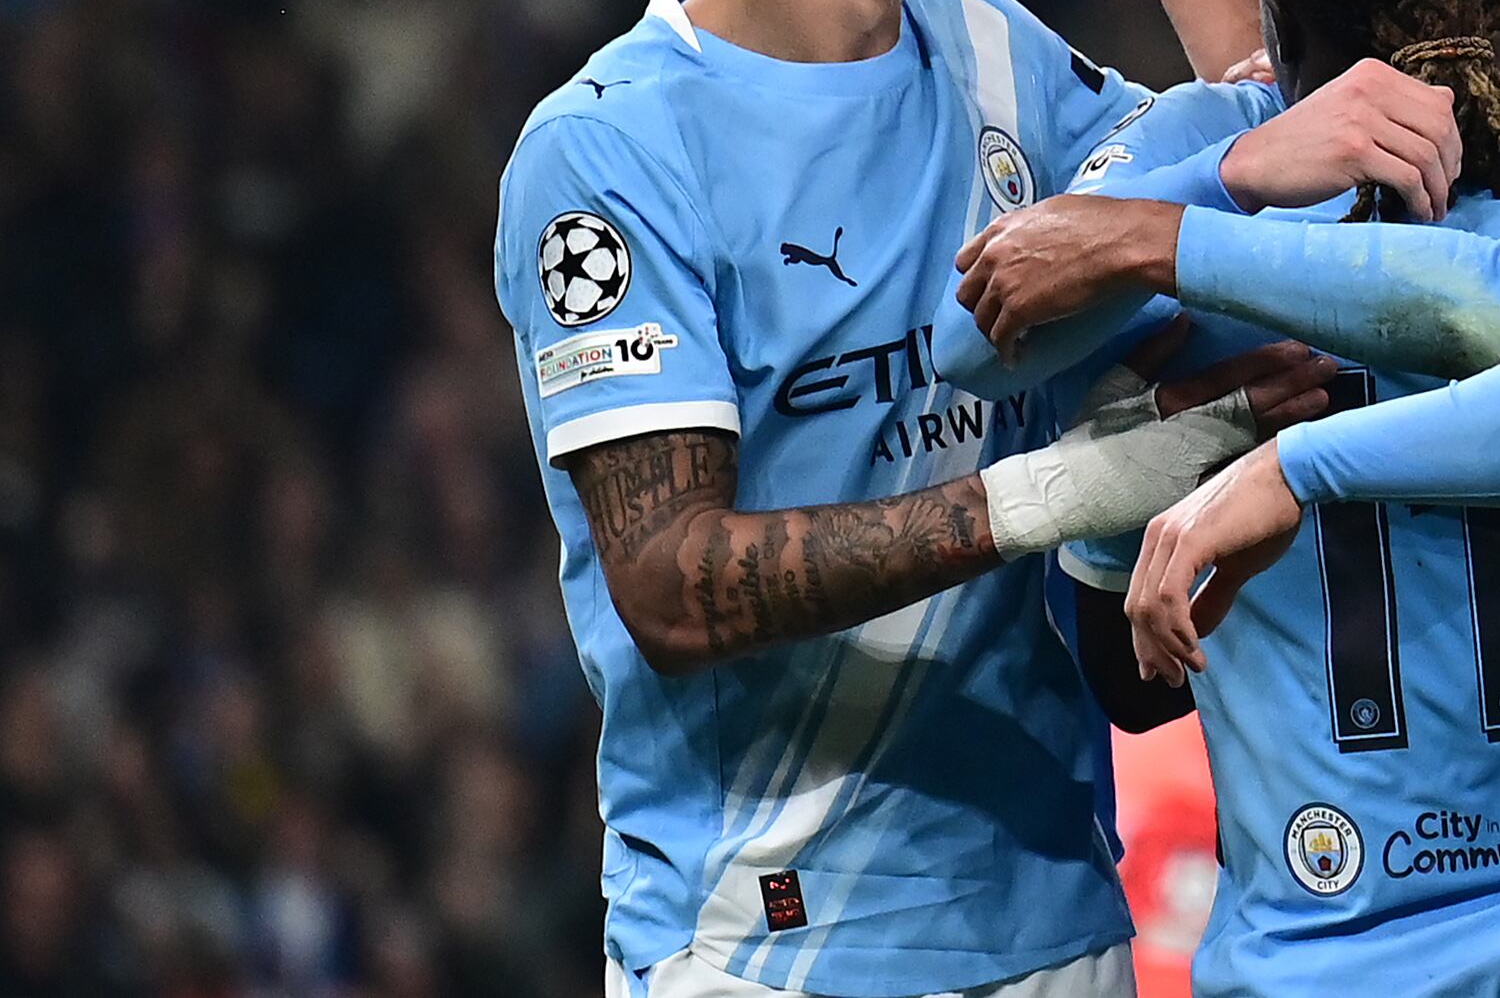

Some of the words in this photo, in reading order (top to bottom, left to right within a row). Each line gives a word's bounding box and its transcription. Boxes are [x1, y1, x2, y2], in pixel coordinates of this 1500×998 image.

[540, 347, 612, 379] FOUNDATION
[615, 338, 653, 362] 10
[1291, 810, 1352, 839] MANCHESTER
[1415, 810, 1482, 842] City
[1486, 818, 1500, 834] in
[1317, 880, 1340, 890] CITY
